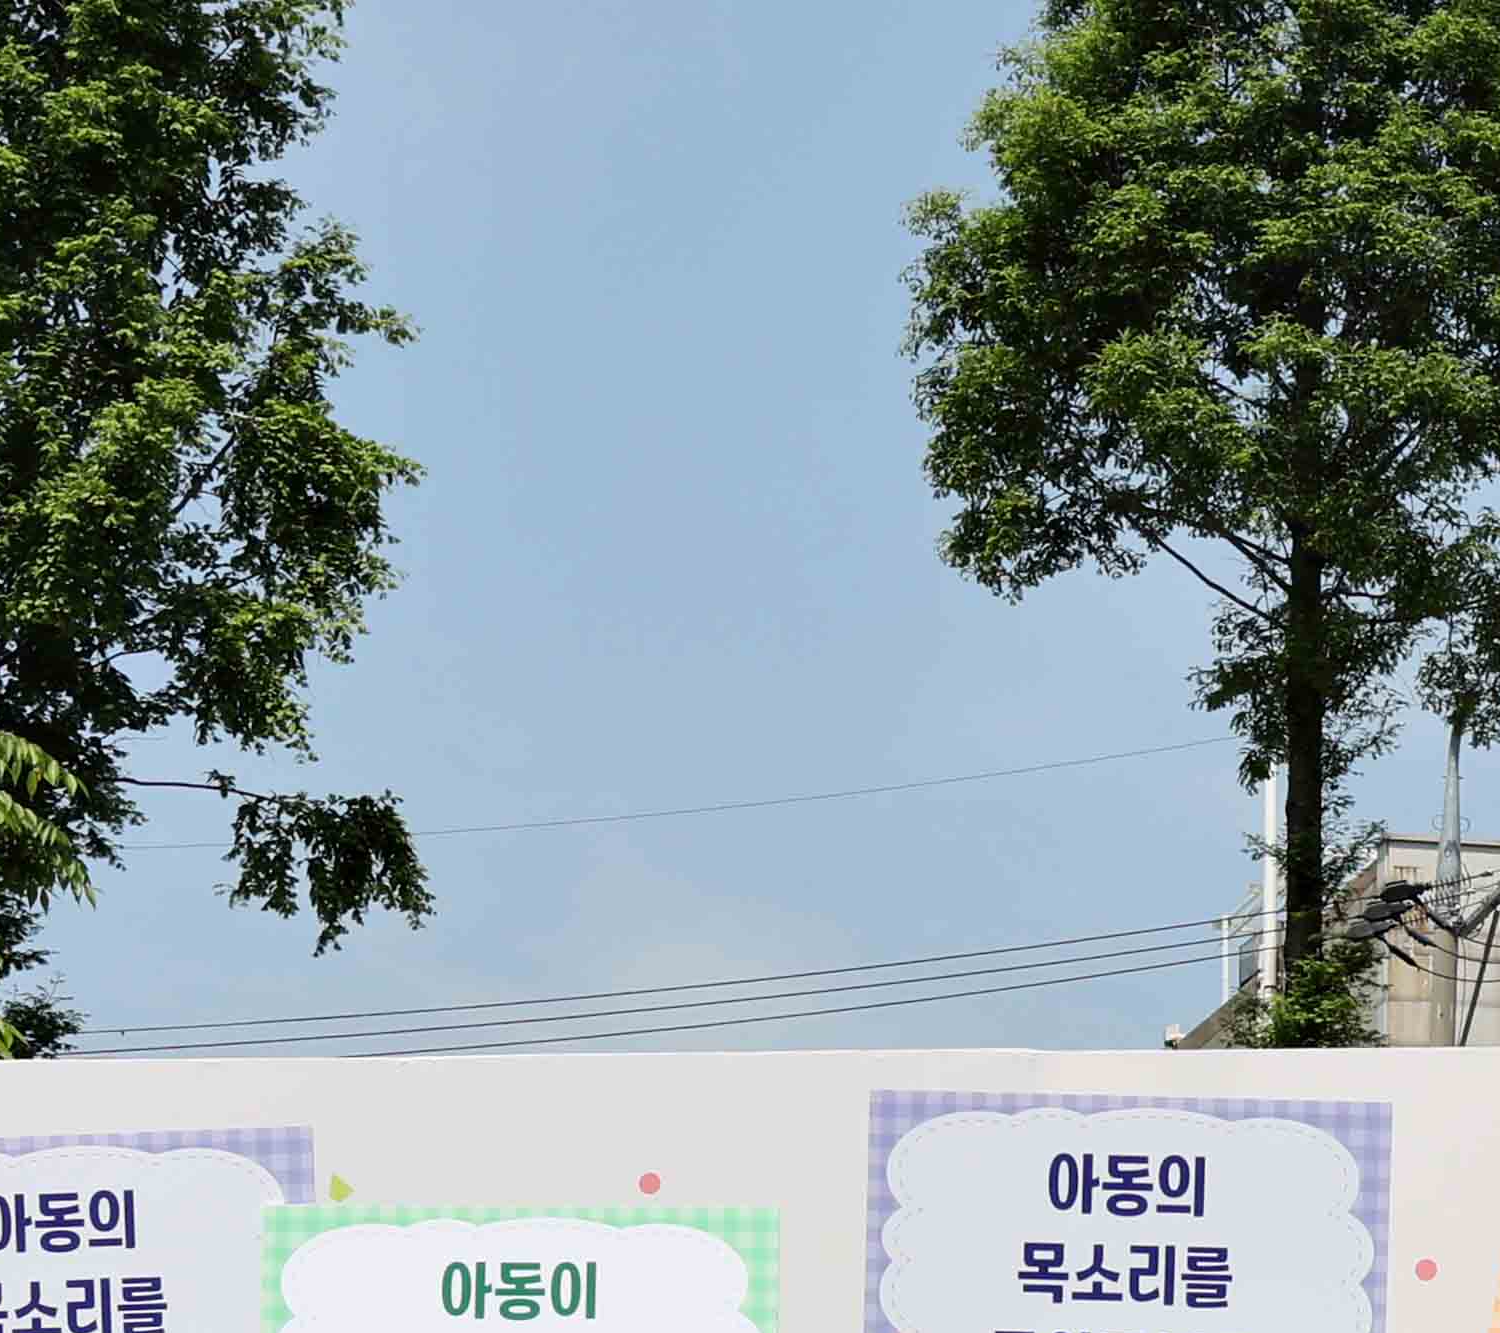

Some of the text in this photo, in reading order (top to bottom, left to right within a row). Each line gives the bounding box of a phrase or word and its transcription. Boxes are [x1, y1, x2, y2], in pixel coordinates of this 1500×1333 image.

[1049, 1153, 1205, 1217] 아동의
[442, 1262, 596, 1320] 아동이
[1018, 1242, 1232, 1308] 목소리를
